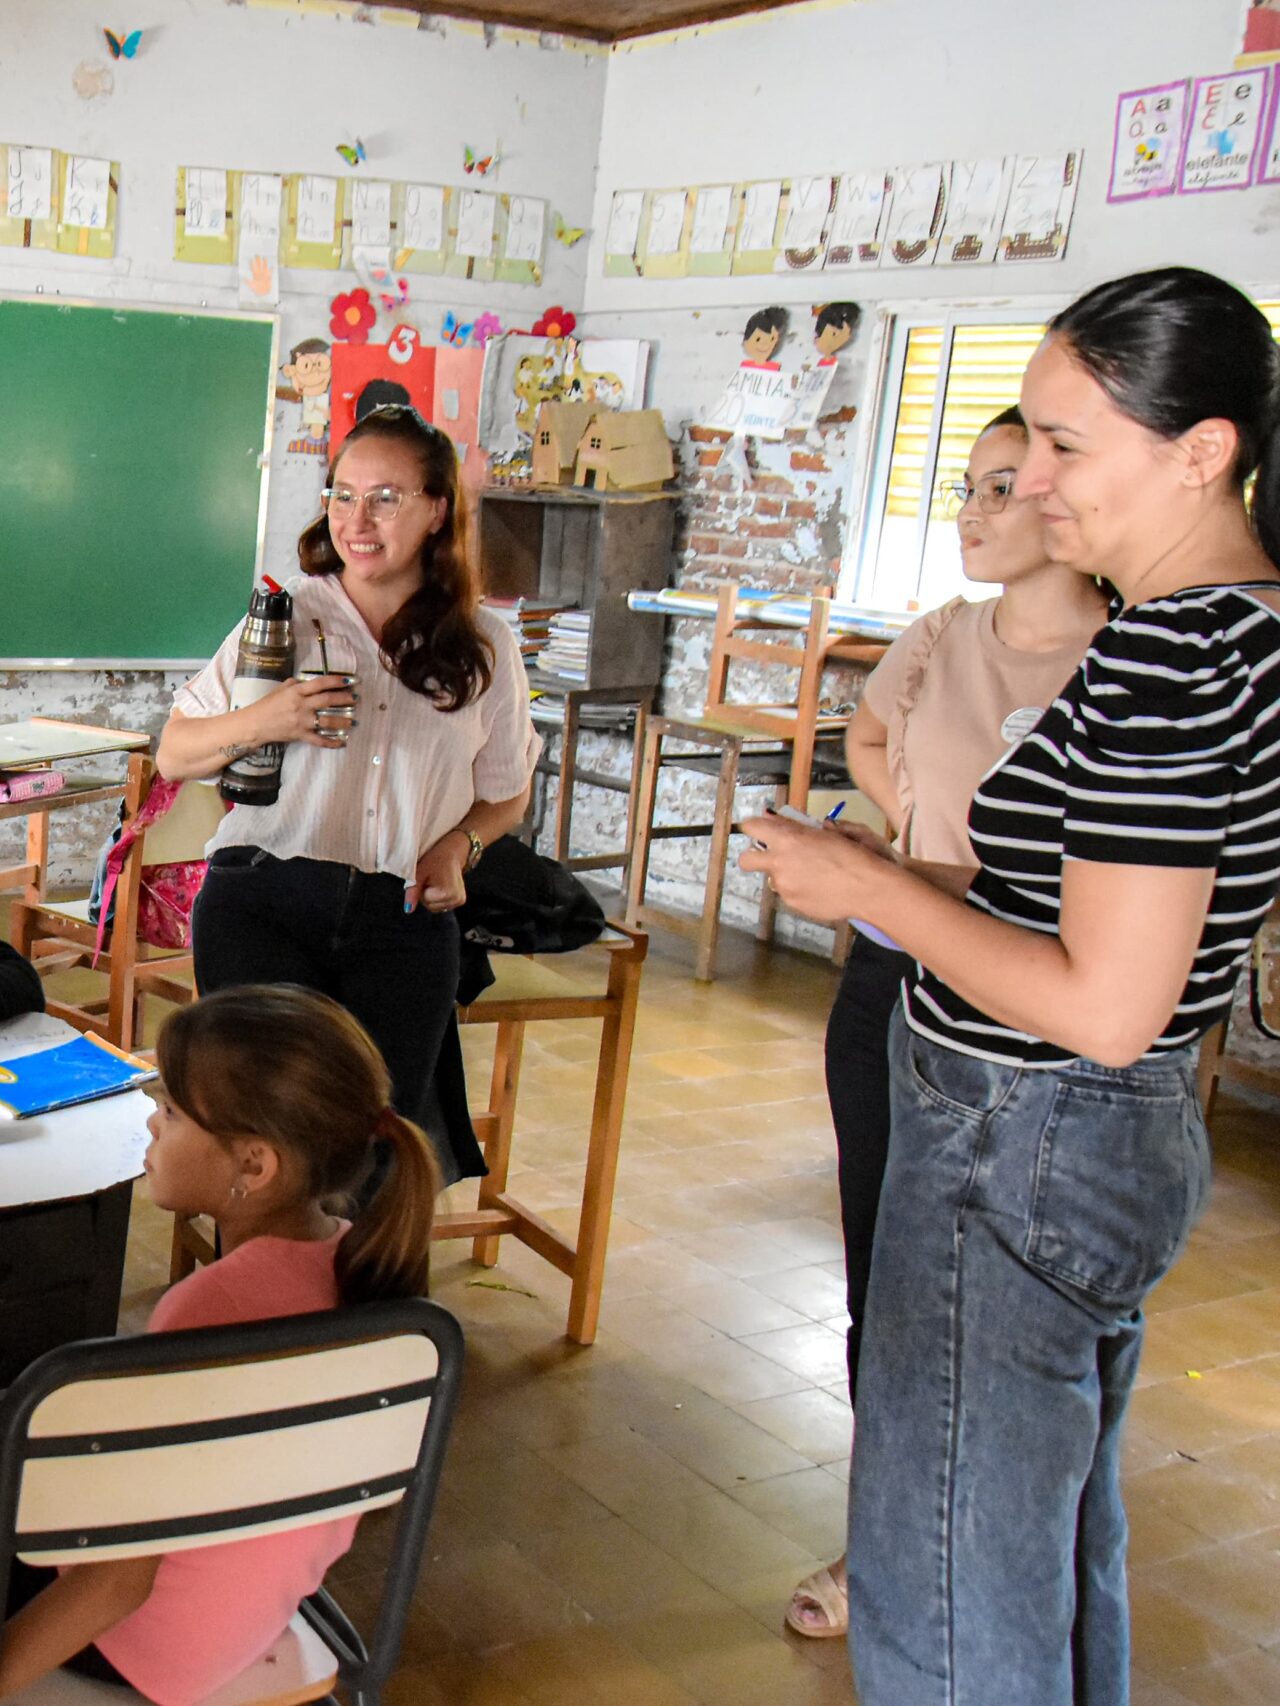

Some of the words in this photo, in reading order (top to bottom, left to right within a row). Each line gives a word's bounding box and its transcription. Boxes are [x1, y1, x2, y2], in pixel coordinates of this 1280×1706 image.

[1130, 98, 1147, 118] A
[1155, 96, 1171, 112] a
[1205, 82, 1225, 106] E
[1234, 83, 1252, 100] e
[69, 155, 88, 191] K
[1016, 157, 1040, 189] Z
[1185, 152, 1249, 171] elefante
[461, 191, 474, 218] P
[388, 326, 417, 365] 3
